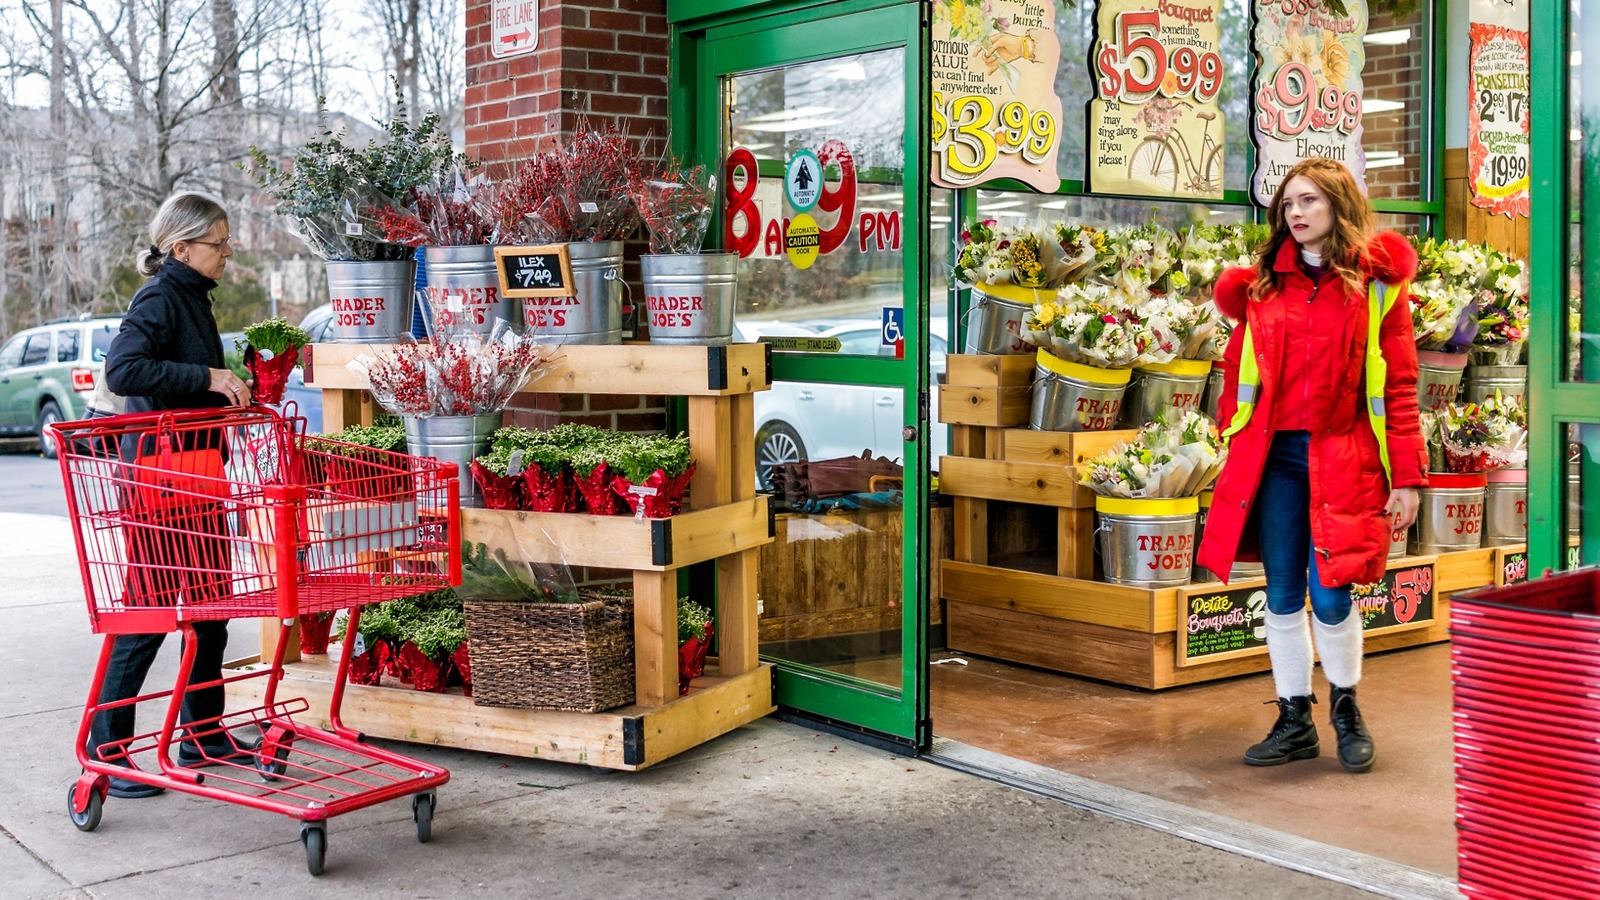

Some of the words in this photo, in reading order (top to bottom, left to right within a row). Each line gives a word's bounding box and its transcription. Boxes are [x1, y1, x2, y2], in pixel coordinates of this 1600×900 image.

[496, 6, 511, 29] FIRE
[514, 2, 533, 25] LANE
[1025, 5, 1045, 17] little
[1158, 0, 1214, 26] Bouquet
[1013, 14, 1050, 30] bunch...
[1309, 10, 1355, 36] Bouquet
[1161, 24, 1200, 39] something
[932, 40, 969, 55] ormous
[1167, 36, 1186, 46] hum
[932, 54, 969, 69] ALUE
[1100, 9, 1222, 99] $5.99
[946, 70, 967, 81] can't
[968, 71, 985, 83] find
[940, 82, 982, 94] anywhere
[1257, 61, 1362, 135] $9.99
[1105, 101, 1120, 112] you
[1103, 116, 1121, 127] may
[932, 92, 1056, 174] $3.99
[1098, 125, 1115, 140] sing
[1116, 125, 1138, 139] along
[1100, 139, 1106, 151] if
[1106, 142, 1122, 153] you
[1296, 138, 1346, 161] Elegant
[1489, 142, 1516, 155] Garden
[1485, 155, 1526, 187] $19.99
[725, 147, 761, 259] 8
[817, 139, 857, 256] 9
[858, 210, 900, 252] PM
[794, 190, 815, 198] AUTOMATIC
[789, 226, 817, 235] AUTOMATIC
[788, 235, 818, 247] CAUTION
[796, 247, 810, 255] DOOR
[518, 257, 545, 268] ILEX
[515, 269, 552, 288] $7.49
[646, 296, 703, 311] TRADER
[337, 312, 376, 327] JOE'S
[651, 312, 693, 327] JOE'S
[807, 339, 821, 350] STAND
[823, 340, 837, 350] CLEAR
[1147, 552, 1192, 570] JOE'S
[1390, 567, 1432, 623] $5.99
[1191, 595, 1233, 614] Petite
[1187, 608, 1245, 633] Bouquets
